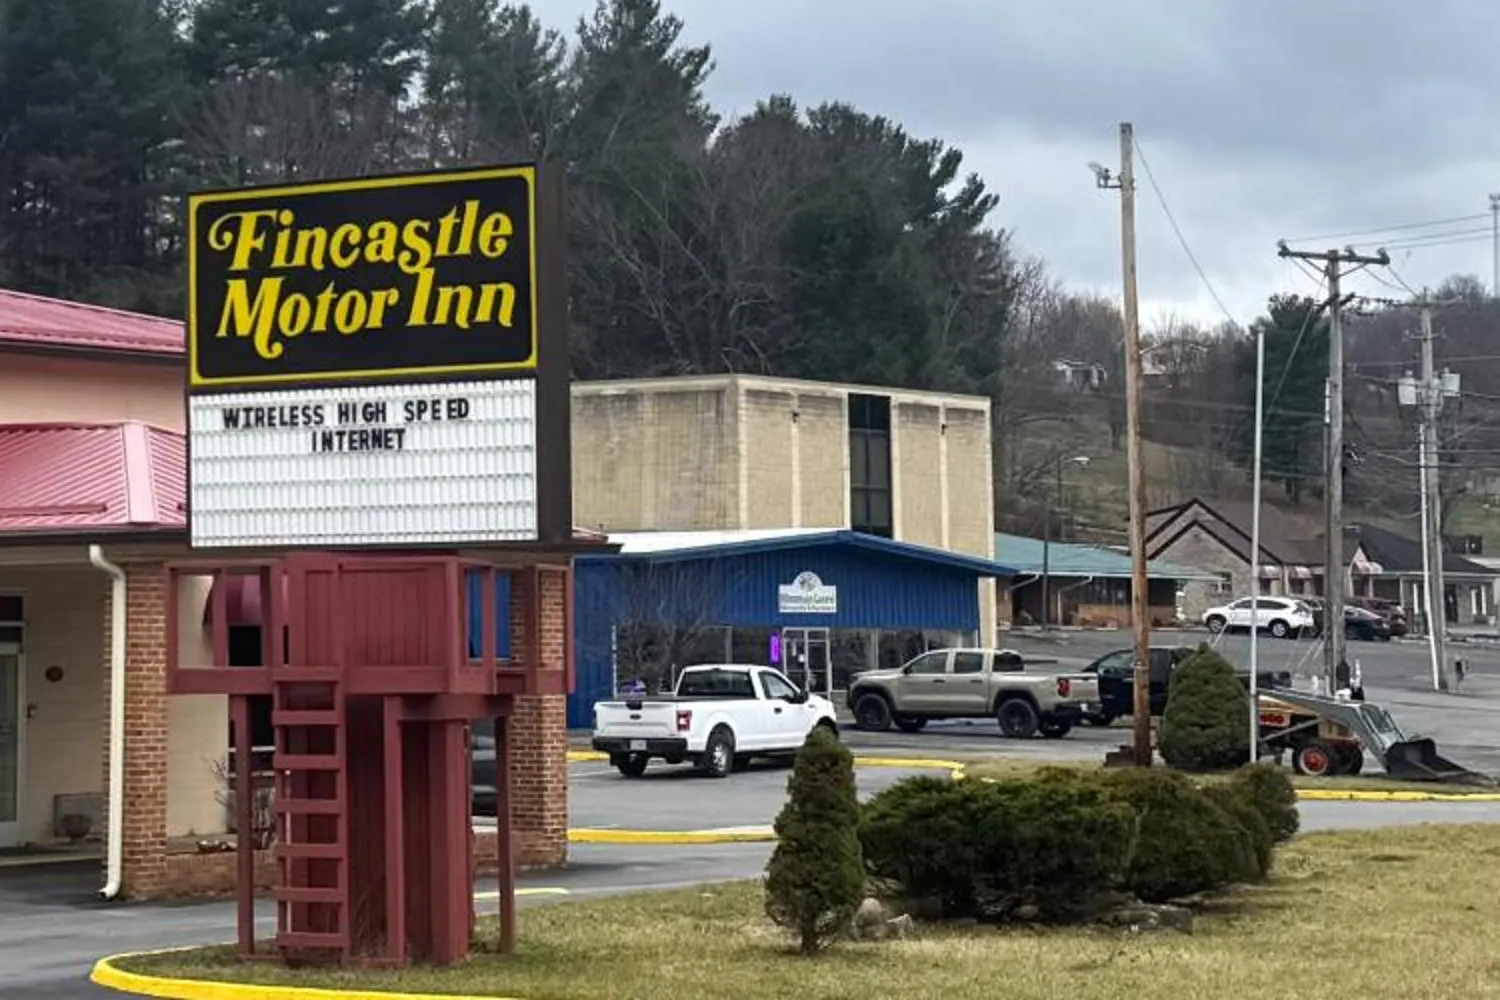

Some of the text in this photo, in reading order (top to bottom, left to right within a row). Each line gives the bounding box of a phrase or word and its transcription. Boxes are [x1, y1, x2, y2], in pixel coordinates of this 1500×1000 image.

[208, 200, 513, 274] Fincastle
[215, 267, 516, 359] Motor Inn
[222, 397, 470, 429] WIRELESS HIGH SPEED
[311, 428, 406, 453] INTERNET
